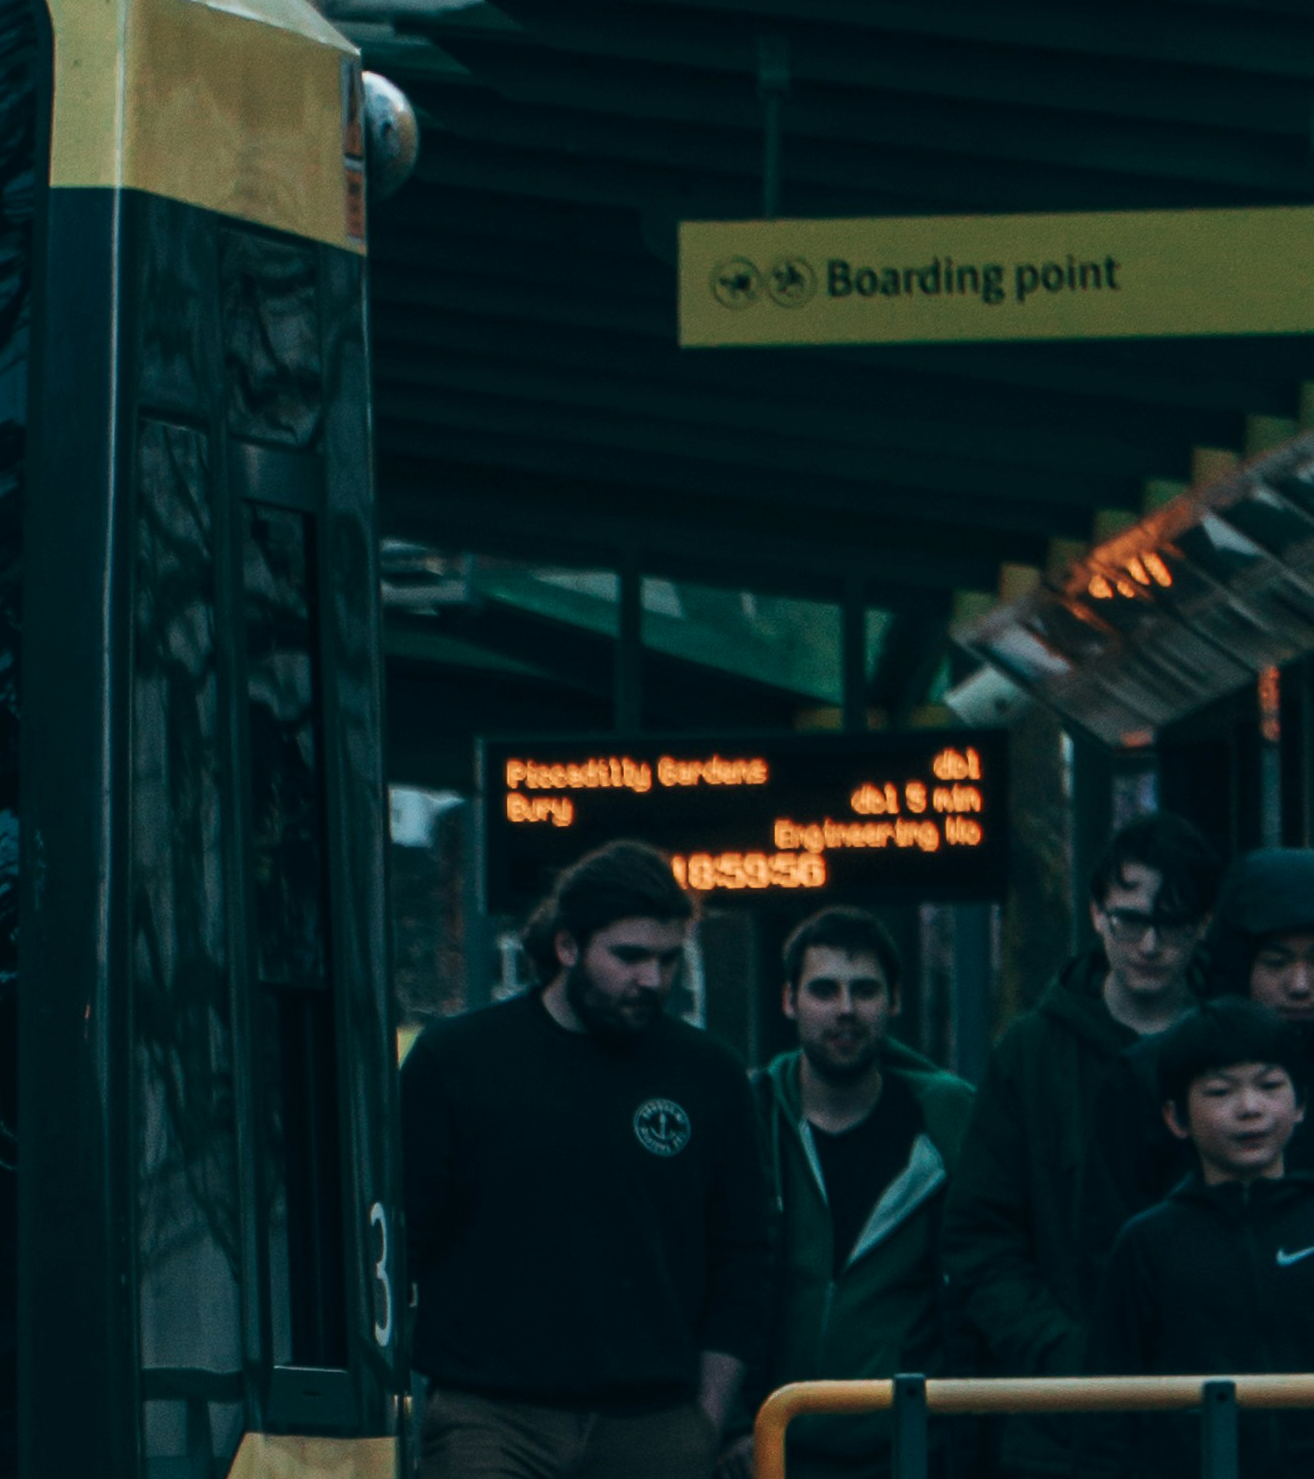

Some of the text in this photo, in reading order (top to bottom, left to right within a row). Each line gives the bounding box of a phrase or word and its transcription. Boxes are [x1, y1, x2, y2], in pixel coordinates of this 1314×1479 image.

[826, 254, 1121, 305] Boarding point
[506, 791, 575, 827] Bury
